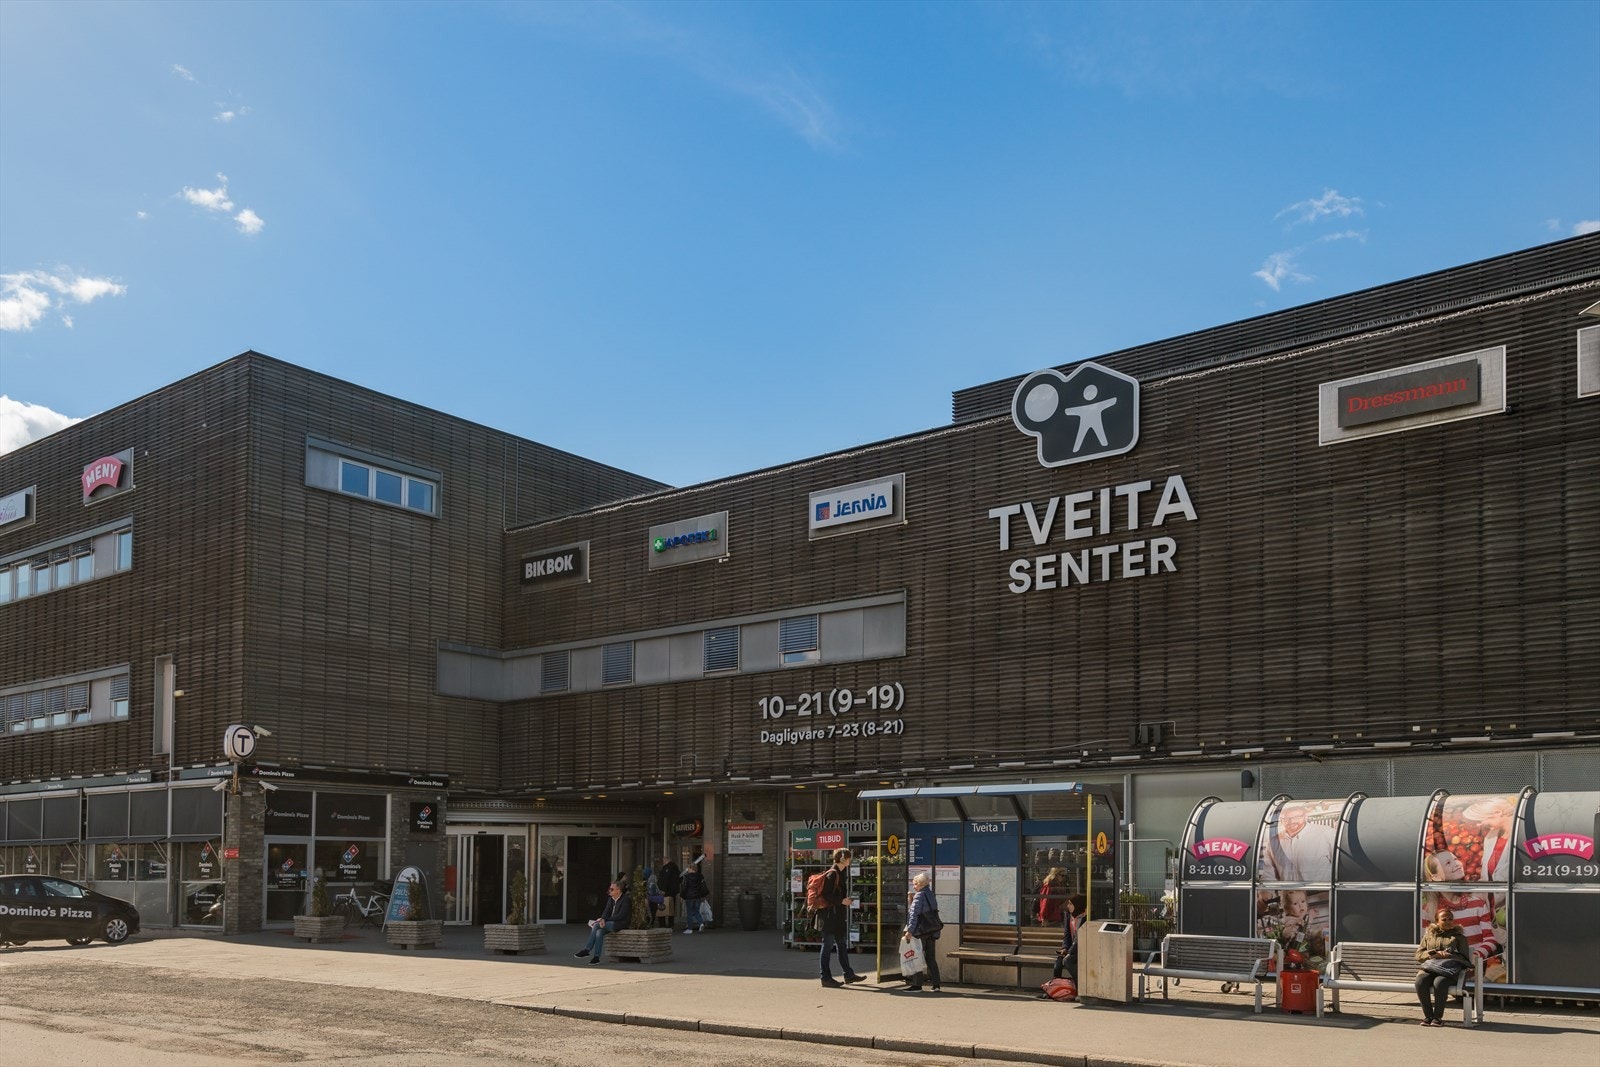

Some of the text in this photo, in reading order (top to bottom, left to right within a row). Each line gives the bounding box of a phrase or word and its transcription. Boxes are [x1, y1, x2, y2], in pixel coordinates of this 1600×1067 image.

[1347, 378, 1467, 413] Dressmann
[86, 463, 117, 488] MENY
[988, 475, 1198, 550] TVEITA
[525, 554, 574, 579] BIK BOK
[1008, 537, 1178, 594] SENTER
[758, 682, 905, 720] 10-21 (9-19)
[760, 719, 905, 746] Dagligvare 7-23 (8-21)
[237, 734, 250, 753] T
[971, 822, 1008, 833] Tveita T
[819, 835, 842, 844] TILBUD
[890, 838, 897, 851] A
[1099, 835, 1105, 850] A
[1198, 841, 1243, 855] MENY
[1532, 837, 1592, 854] MENY
[0, 905, 93, 918] Domino's Pizza
